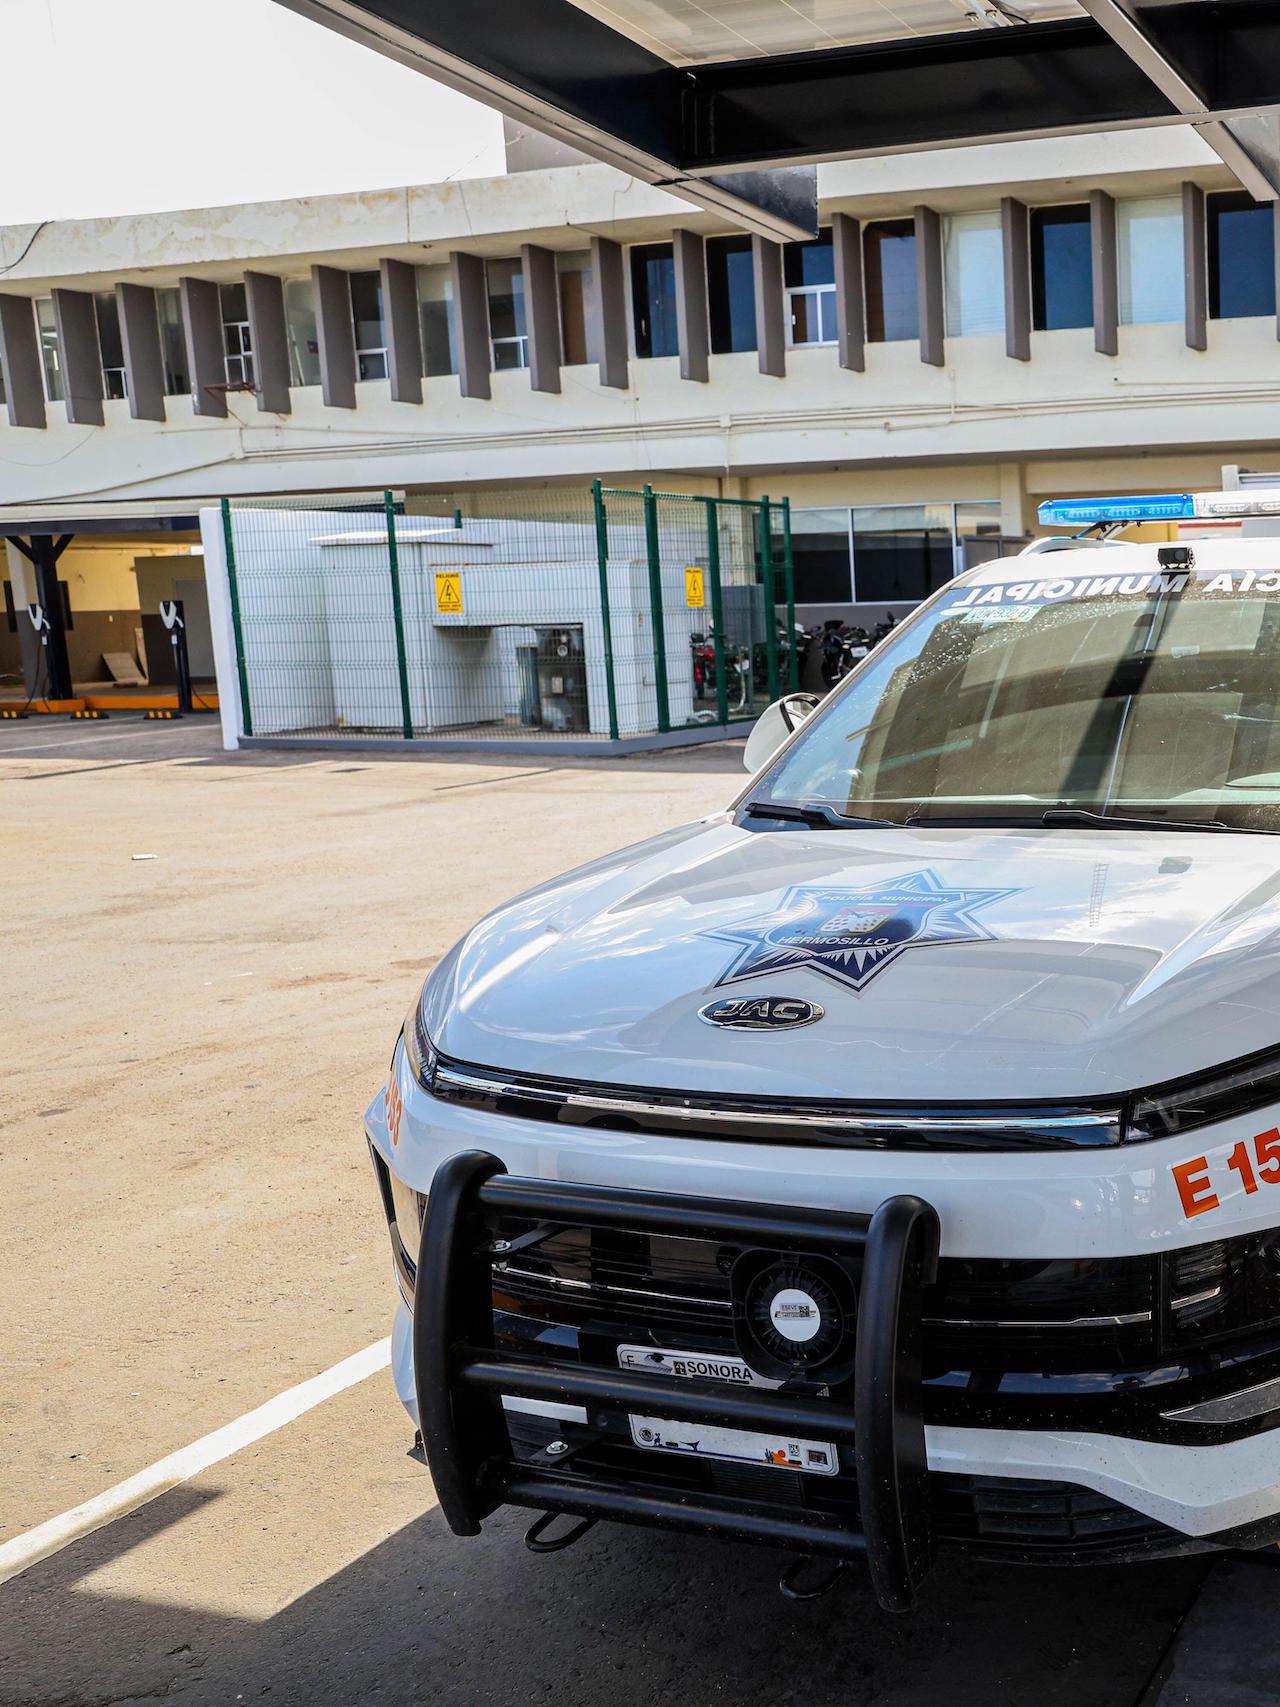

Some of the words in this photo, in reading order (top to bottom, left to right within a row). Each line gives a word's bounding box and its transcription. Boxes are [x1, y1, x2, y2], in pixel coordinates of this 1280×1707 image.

[878, 895, 950, 903] MUNICIPAL
[776, 935, 890, 947] HERMOSILLO
[713, 1000, 806, 1020] JAC
[1171, 1155, 1220, 1219] E
[687, 1361, 754, 1381] SONORA
